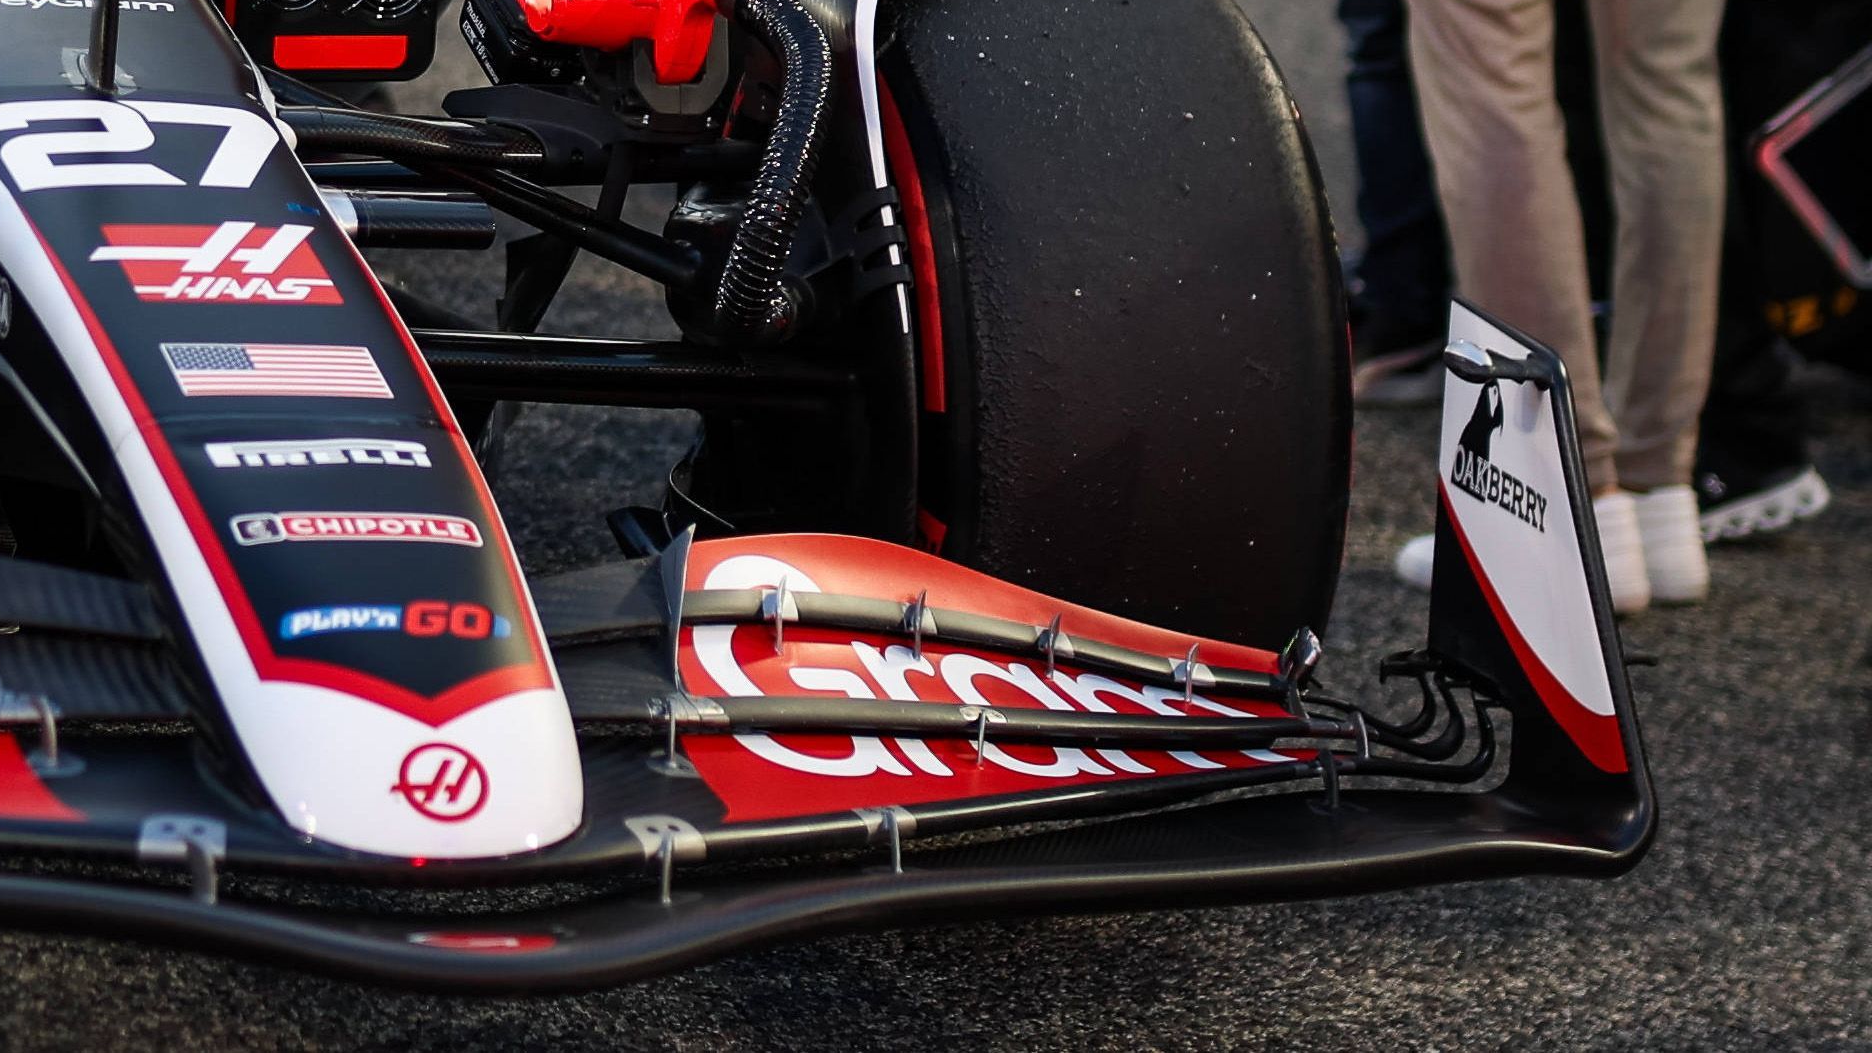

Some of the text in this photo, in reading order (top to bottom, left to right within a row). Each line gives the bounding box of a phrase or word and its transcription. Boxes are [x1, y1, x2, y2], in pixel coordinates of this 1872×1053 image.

[134, 276, 334, 300] HAAS
[205, 438, 432, 468] PIRELLI
[1450, 445, 1548, 533] OAKBERRY
[288, 517, 470, 540] CHIPOTLE
[291, 600, 494, 640] PLAY'n GO
[692, 554, 1299, 778] Gram
